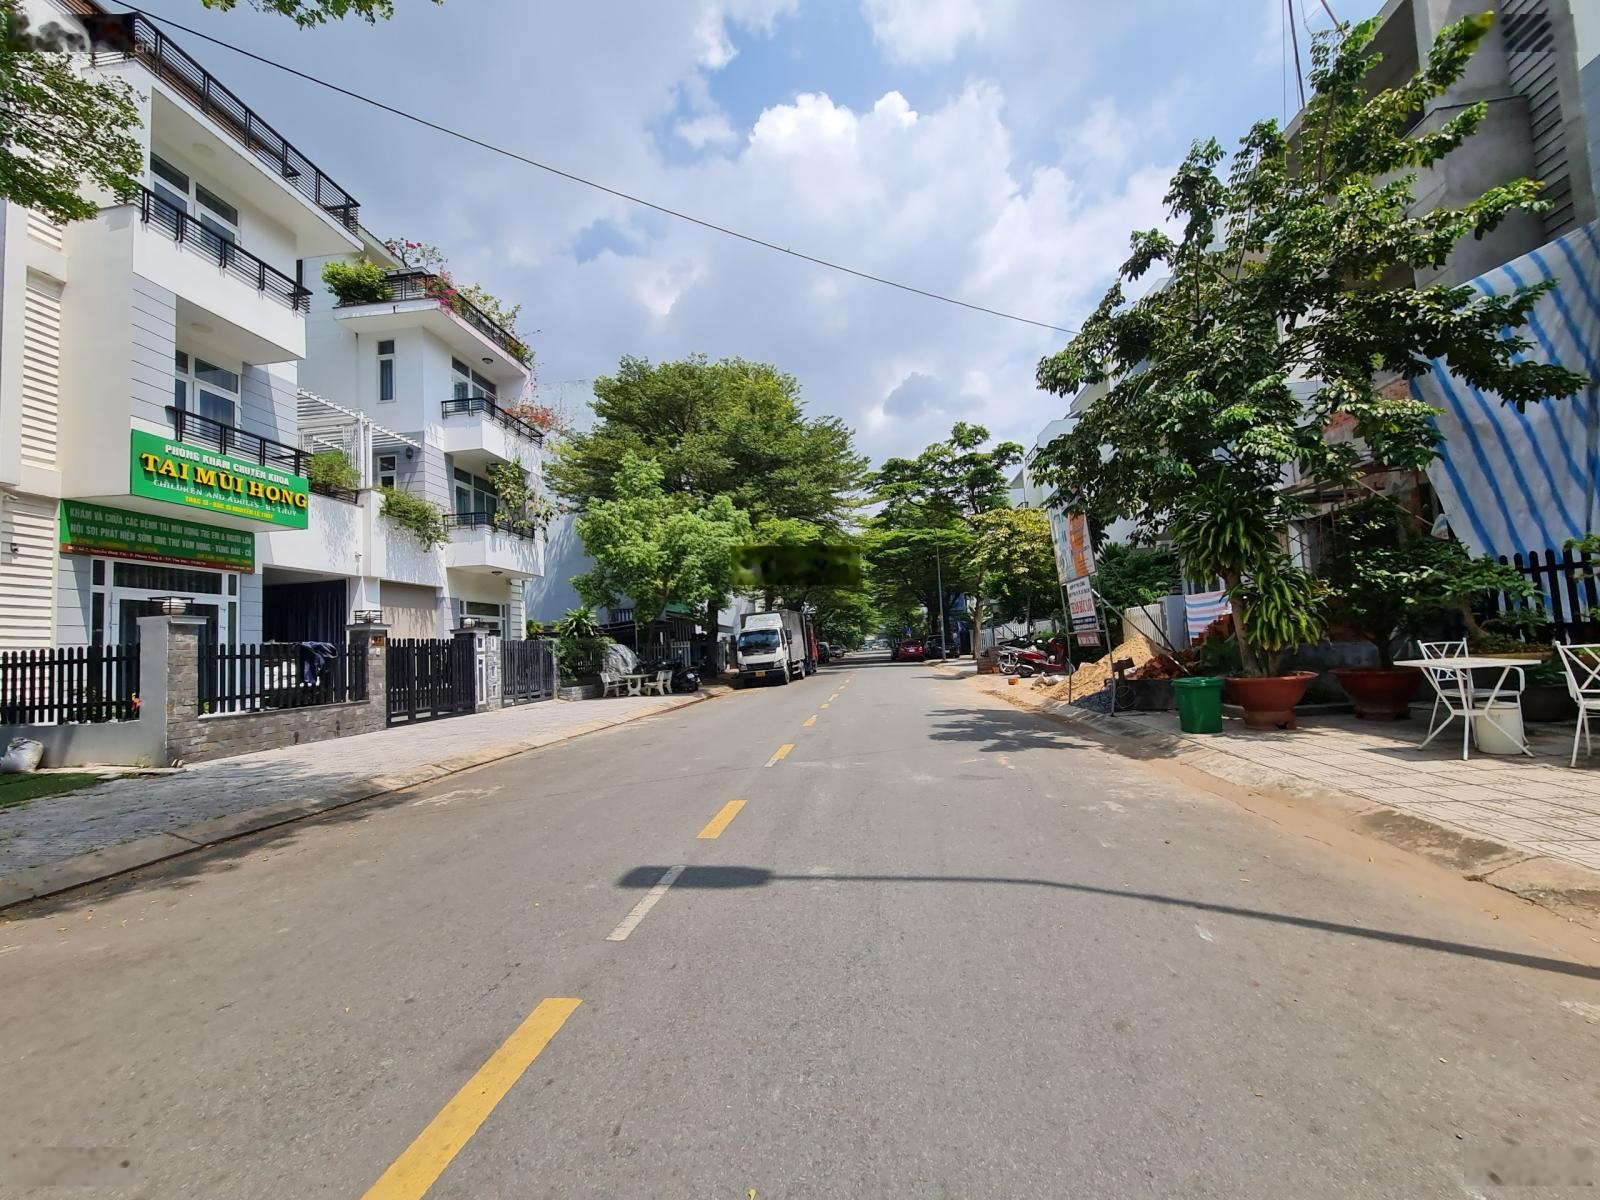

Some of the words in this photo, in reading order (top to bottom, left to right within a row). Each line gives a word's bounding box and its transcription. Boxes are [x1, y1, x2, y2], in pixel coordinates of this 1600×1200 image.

[164, 444, 200, 462] PHÒNG
[202, 455, 231, 470] KHÁM
[232, 463, 266, 480] CHUYÊN
[268, 473, 290, 486] KHOA
[141, 452, 190, 480] TAI
[195, 466, 244, 493] MŨI
[249, 480, 307, 508] HỌNG
[153, 479, 203, 496] CHILDREN
[206, 492, 225, 501] AND
[70, 507, 93, 520] KHÁM
[94, 510, 103, 521] VÀ
[125, 515, 139, 527] CÁC
[100, 526, 118, 539] PHÁT
